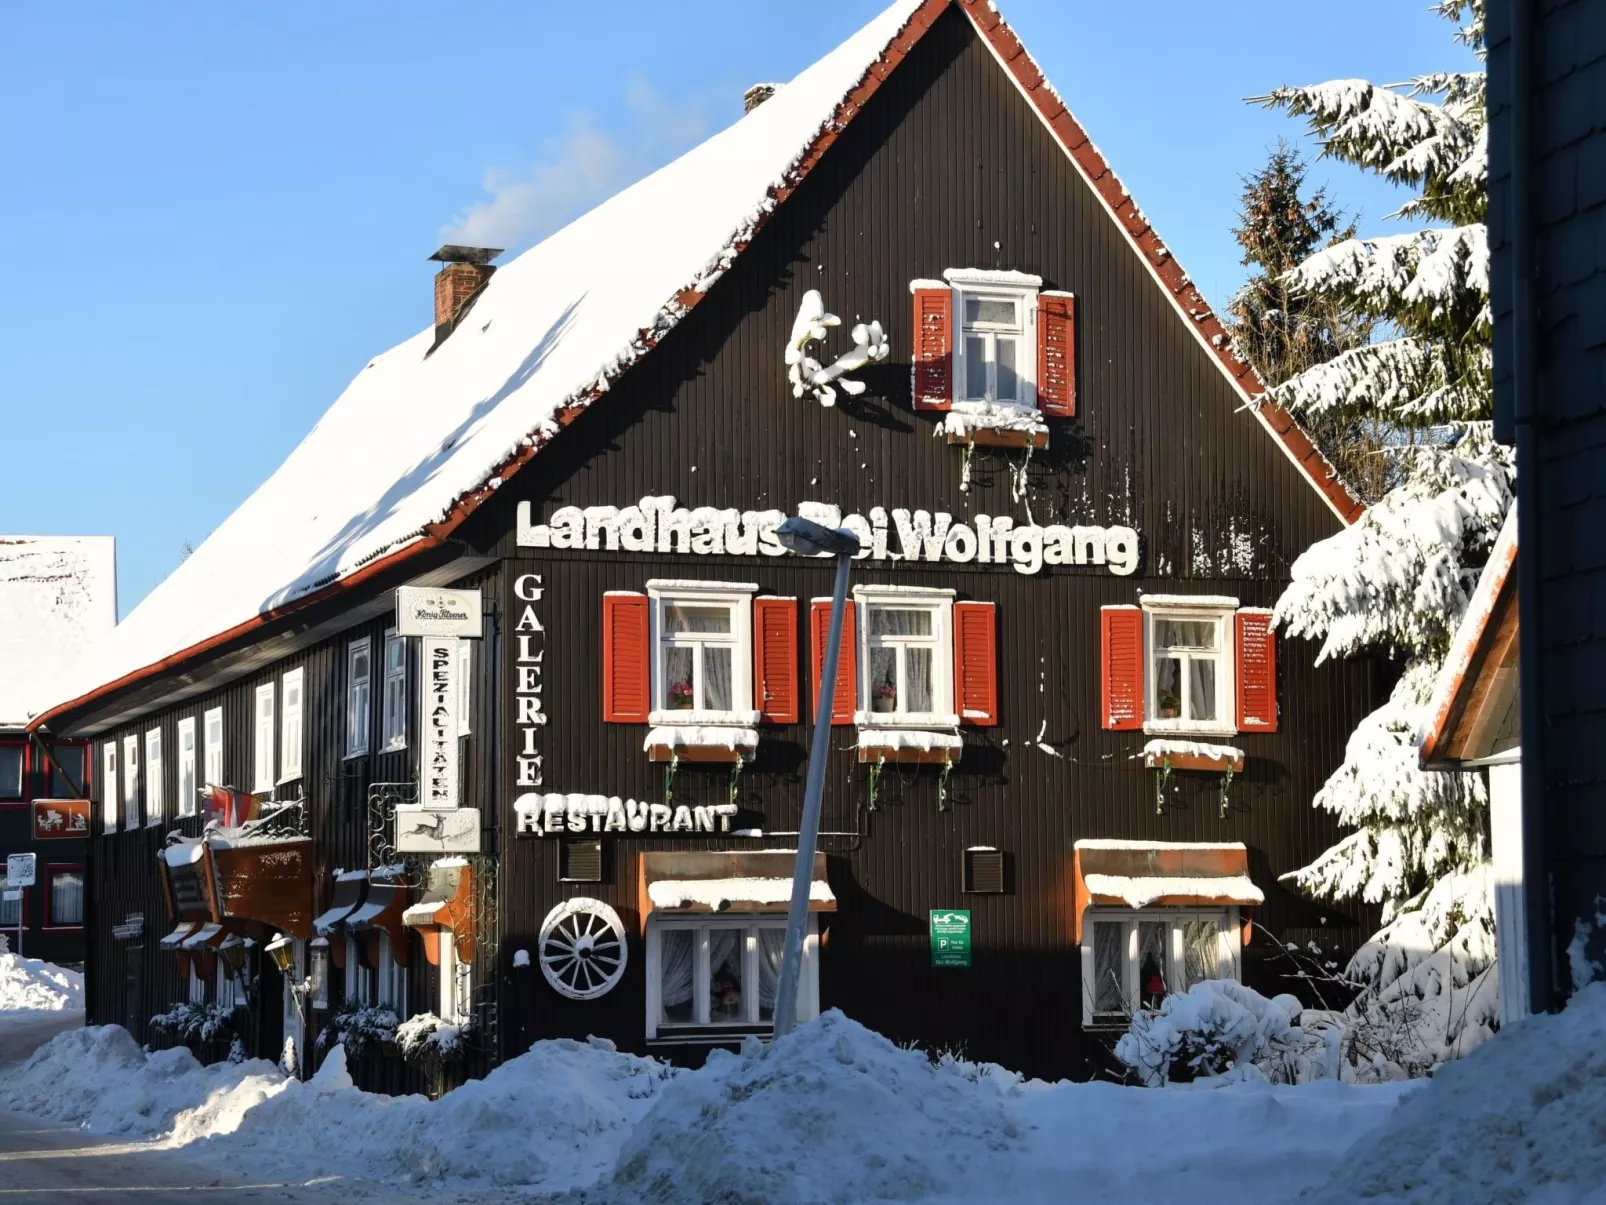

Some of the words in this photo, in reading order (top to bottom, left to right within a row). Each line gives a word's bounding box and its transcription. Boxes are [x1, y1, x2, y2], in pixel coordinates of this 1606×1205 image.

[516, 496, 788, 557] Landhaus
[892, 508, 1140, 575] Wolfgang
[415, 609, 438, 620] König
[439, 609, 469, 620] Pilsener
[514, 574, 547, 786] GALERIE
[514, 794, 738, 834] RESTAURANT
